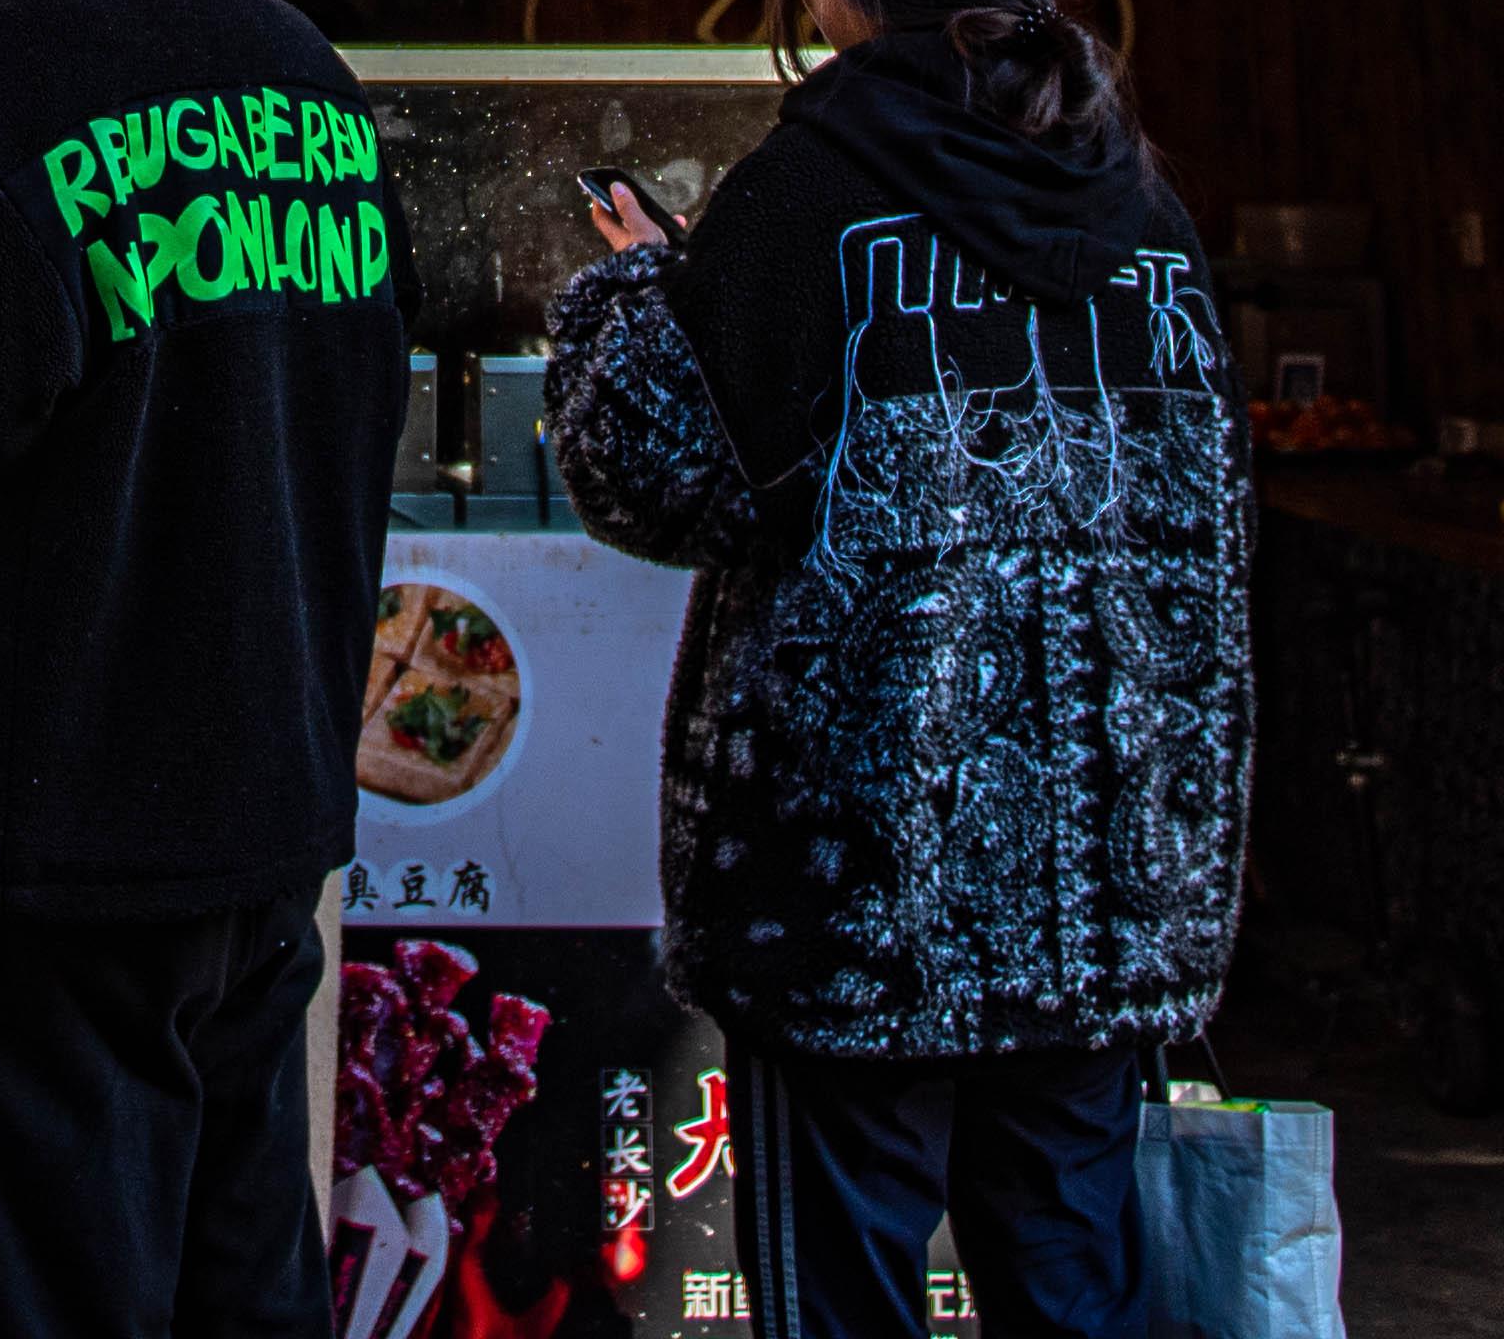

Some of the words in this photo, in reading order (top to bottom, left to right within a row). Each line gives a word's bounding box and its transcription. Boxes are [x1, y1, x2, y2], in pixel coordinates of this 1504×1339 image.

[343, 860, 490, 914] 臭豆腐
[602, 1067, 652, 1229] 老长沙
